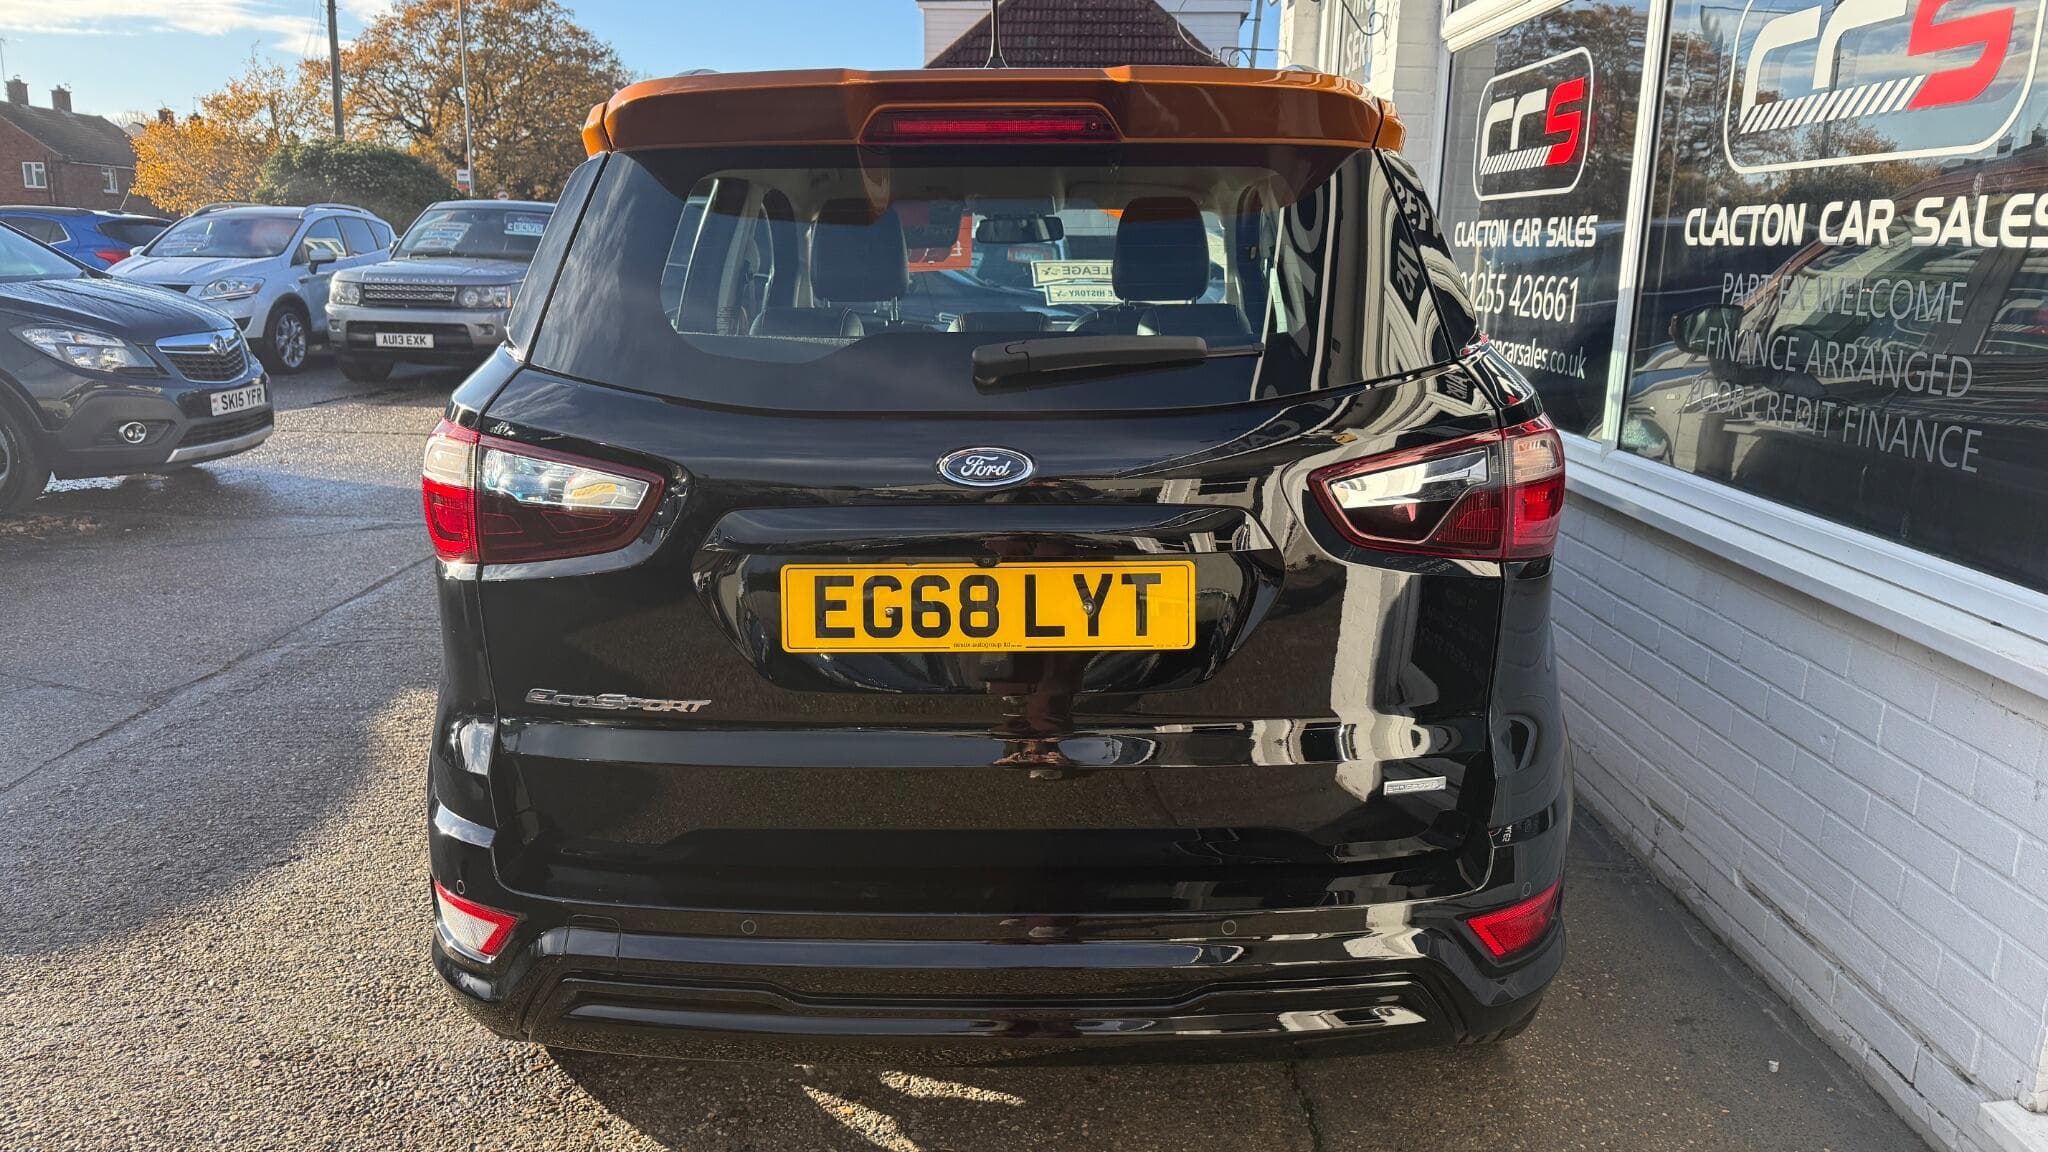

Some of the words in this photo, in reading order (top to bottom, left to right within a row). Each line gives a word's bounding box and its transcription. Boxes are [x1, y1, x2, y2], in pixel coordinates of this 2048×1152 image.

[1454, 219, 1510, 248] CLACTON
[1512, 217, 1543, 248] CAR
[1546, 214, 1599, 248] SALES
[1683, 202, 1808, 247] CLACTON
[1818, 199, 1896, 247] CAR
[1508, 273, 1580, 324] 426661
[1721, 272, 1774, 306] PART
[1779, 274, 1809, 313] EX
[1816, 276, 1968, 325] WELCOME
[382, 334, 404, 345] AU13
[406, 335, 426, 346] EXK
[1490, 337, 1587, 380] ncarsales.co.uk
[1705, 327, 1800, 373] FINANCE
[1804, 340, 1973, 399] ARRANGED
[221, 391, 245, 411] SK15
[246, 387, 263, 406] YFR
[1690, 376, 1744, 418] POOR
[1843, 407, 1983, 474] FINANCE
[960, 455, 1012, 477] Ford
[814, 574, 1000, 640] EG68
[1024, 573, 1162, 639] LYT
